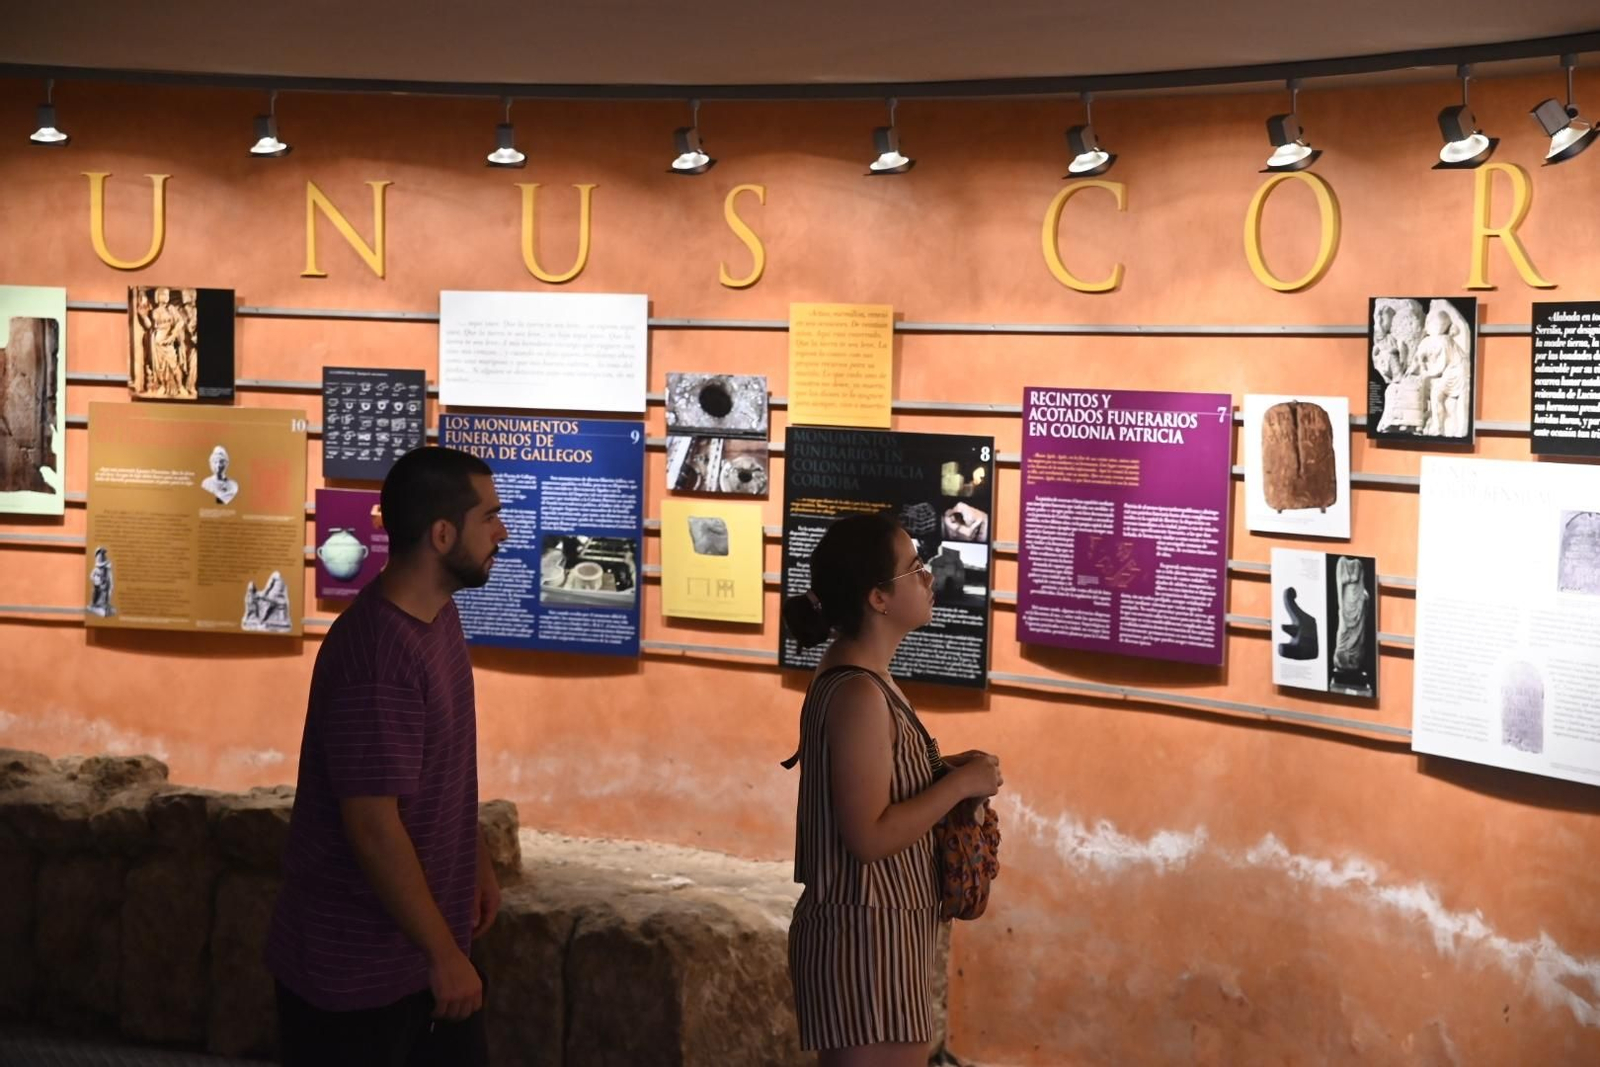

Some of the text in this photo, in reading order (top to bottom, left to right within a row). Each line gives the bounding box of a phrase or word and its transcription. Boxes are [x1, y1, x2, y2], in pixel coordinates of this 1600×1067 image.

[1581, 314, 1591, 322] en
[1535, 337, 1543, 348] la
[1030, 391, 1112, 408] RECINTOS Y
[1566, 388, 1577, 399] de
[1028, 407, 1198, 428] ACOTADOS FUNERARIOS
[1216, 406, 1227, 423] 7
[445, 417, 579, 434] LOS MONUMENTOS
[1029, 423, 1184, 444] EN COLONIA PATRICIA
[445, 431, 554, 447] FUNERARIOS DE
[630, 429, 640, 444] 9
[793, 430, 899, 447] MONUMENTOS
[499, 447, 517, 460] DE
[521, 448, 593, 464] GALLEGOS
[793, 443, 903, 463] FUNERARIOS EN
[980, 446, 991, 462] 8
[791, 457, 925, 481] COLONIA PATRICIA
[791, 472, 860, 490] CORDUBA
